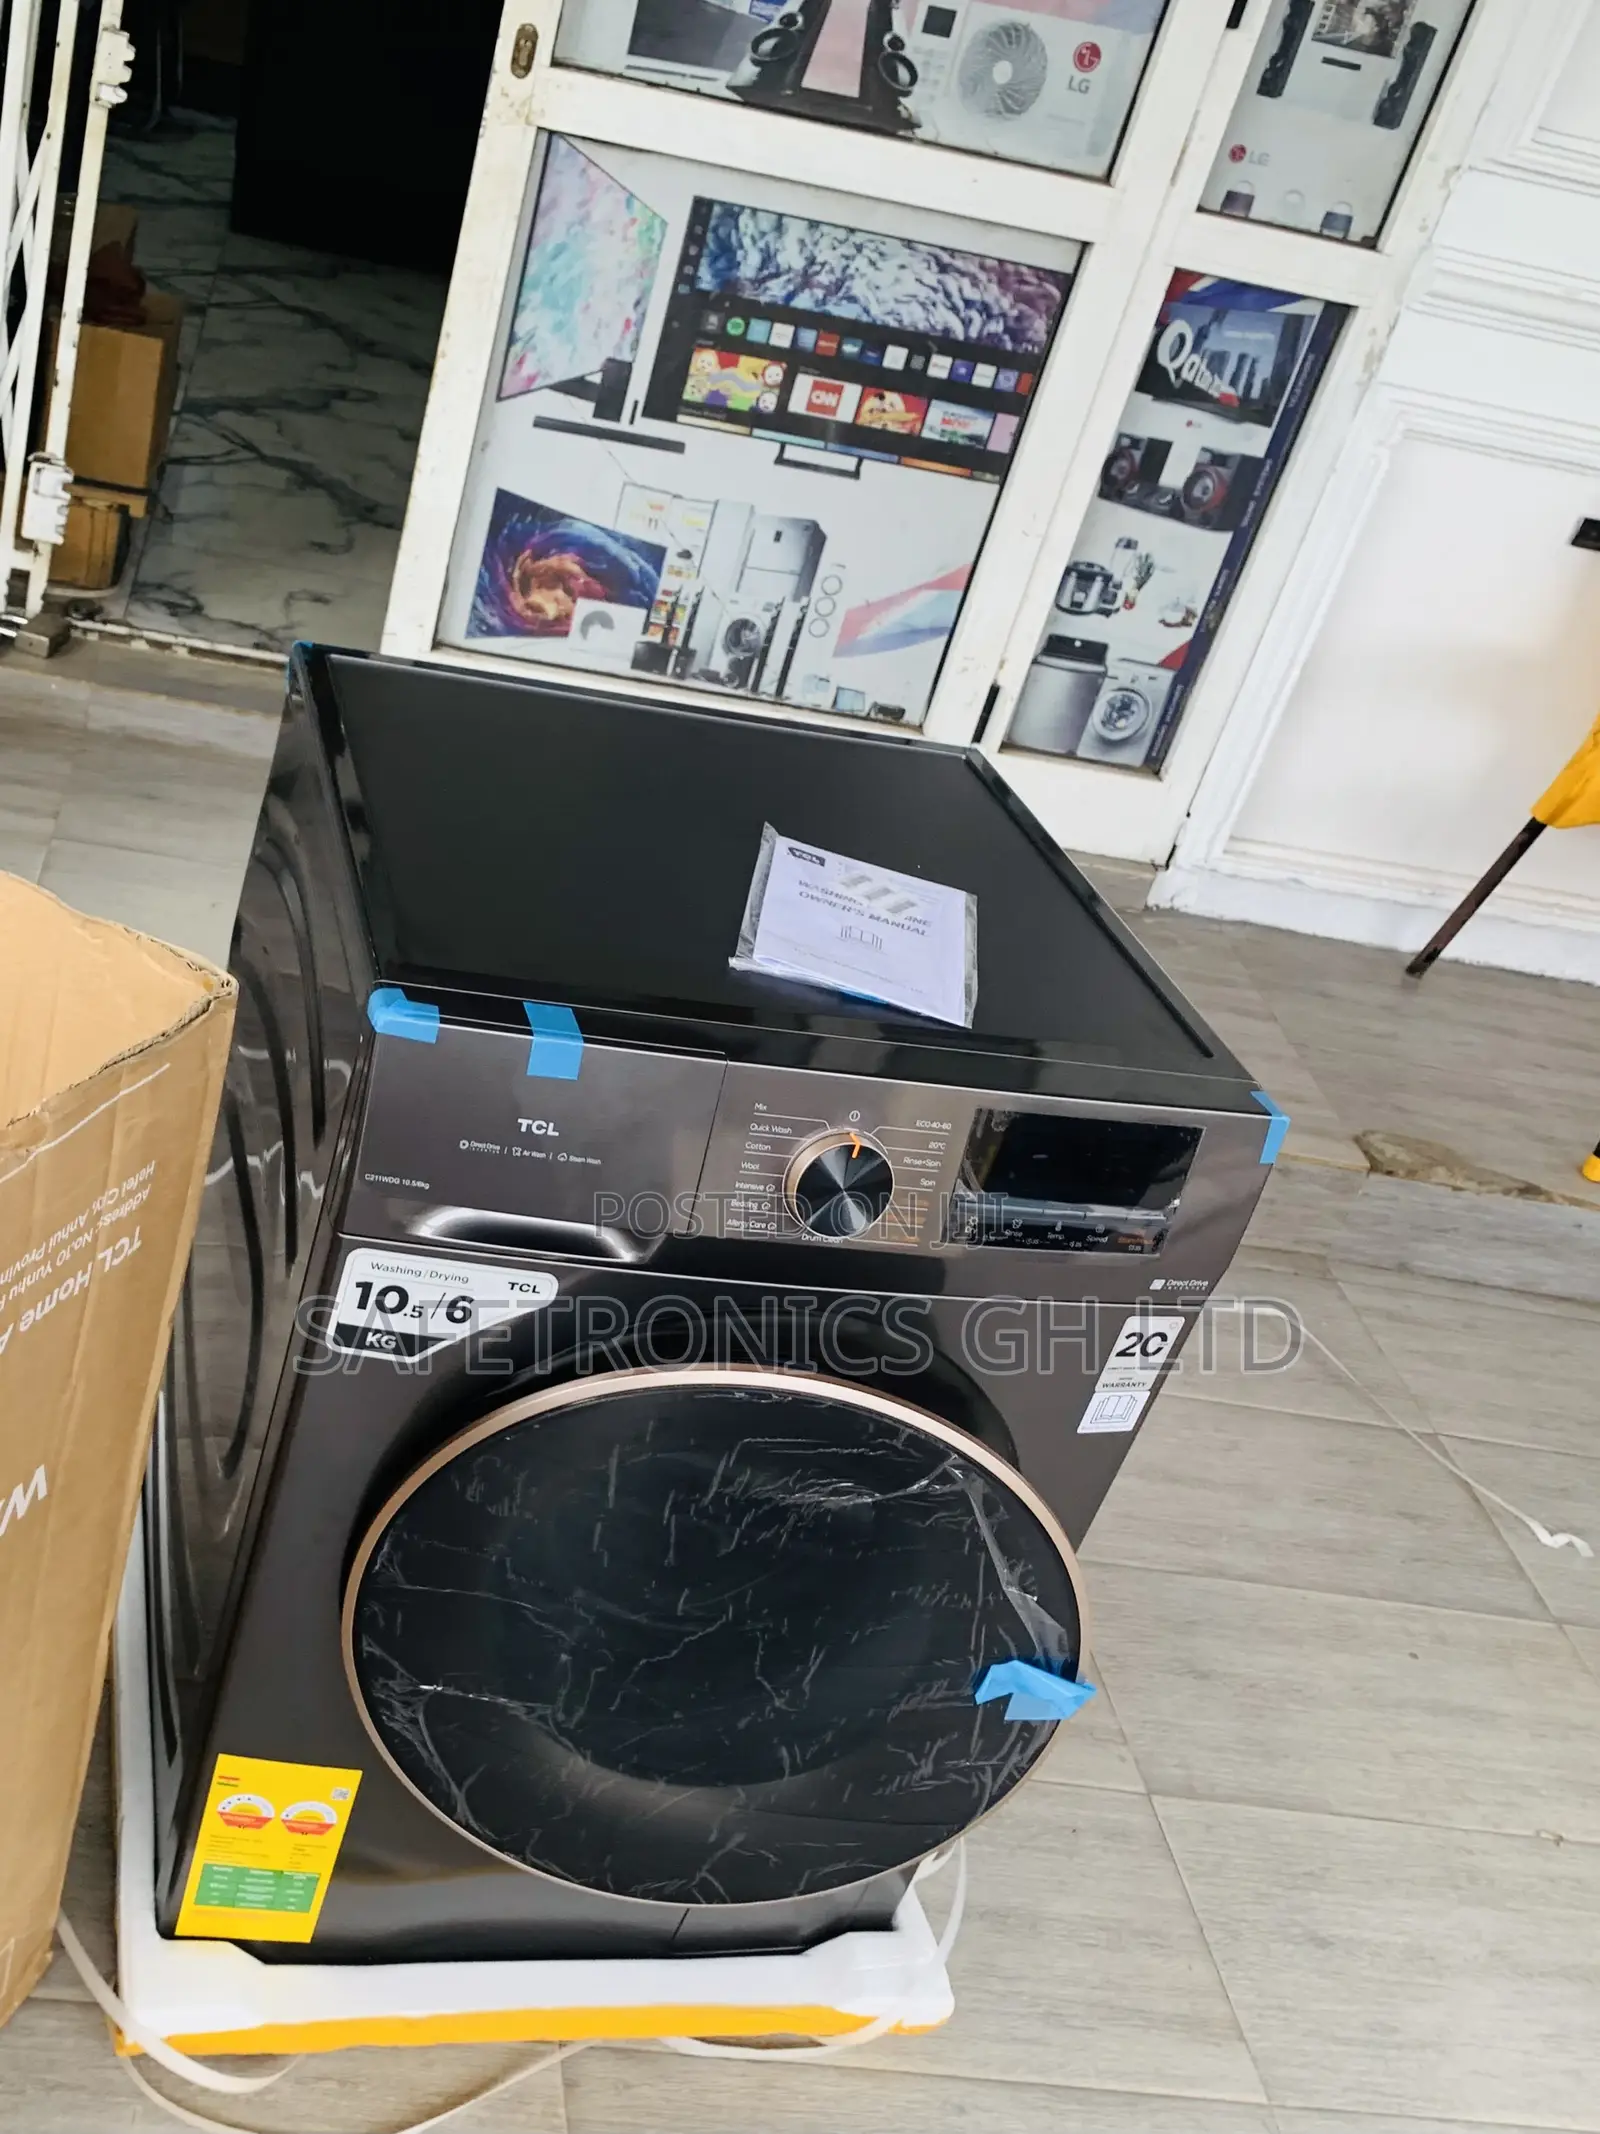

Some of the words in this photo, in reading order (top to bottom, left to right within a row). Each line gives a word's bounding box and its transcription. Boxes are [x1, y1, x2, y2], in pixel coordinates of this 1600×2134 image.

[1067, 75, 1091, 94] LG
[799, 891, 865, 917] OWNER'S
[868, 912, 927, 936] MANUAL
[754, 1102, 767, 1111] Mix
[518, 1117, 559, 1137] TCL
[749, 1123, 770, 1132] Quick
[771, 1125, 792, 1135] Wash
[745, 1141, 771, 1151] Cotton
[741, 1161, 760, 1170] Wool
[735, 1181, 765, 1192] Intensive
[920, 1178, 936, 1187] Spin
[49, 1209, 89, 1252] Anhui
[749, 1221, 766, 1229] Care
[1086, 1234, 1108, 1244] Speed
[98, 1226, 141, 1272] TCL
[508, 1281, 541, 1294] TCL
[1166, 1279, 1189, 1287] Direct
[1189, 1279, 1208, 1287] Drive
[20, 1262, 93, 1332] Home
[365, 1332, 397, 1350] KG
[1102, 1381, 1147, 1389] WARRANTY
